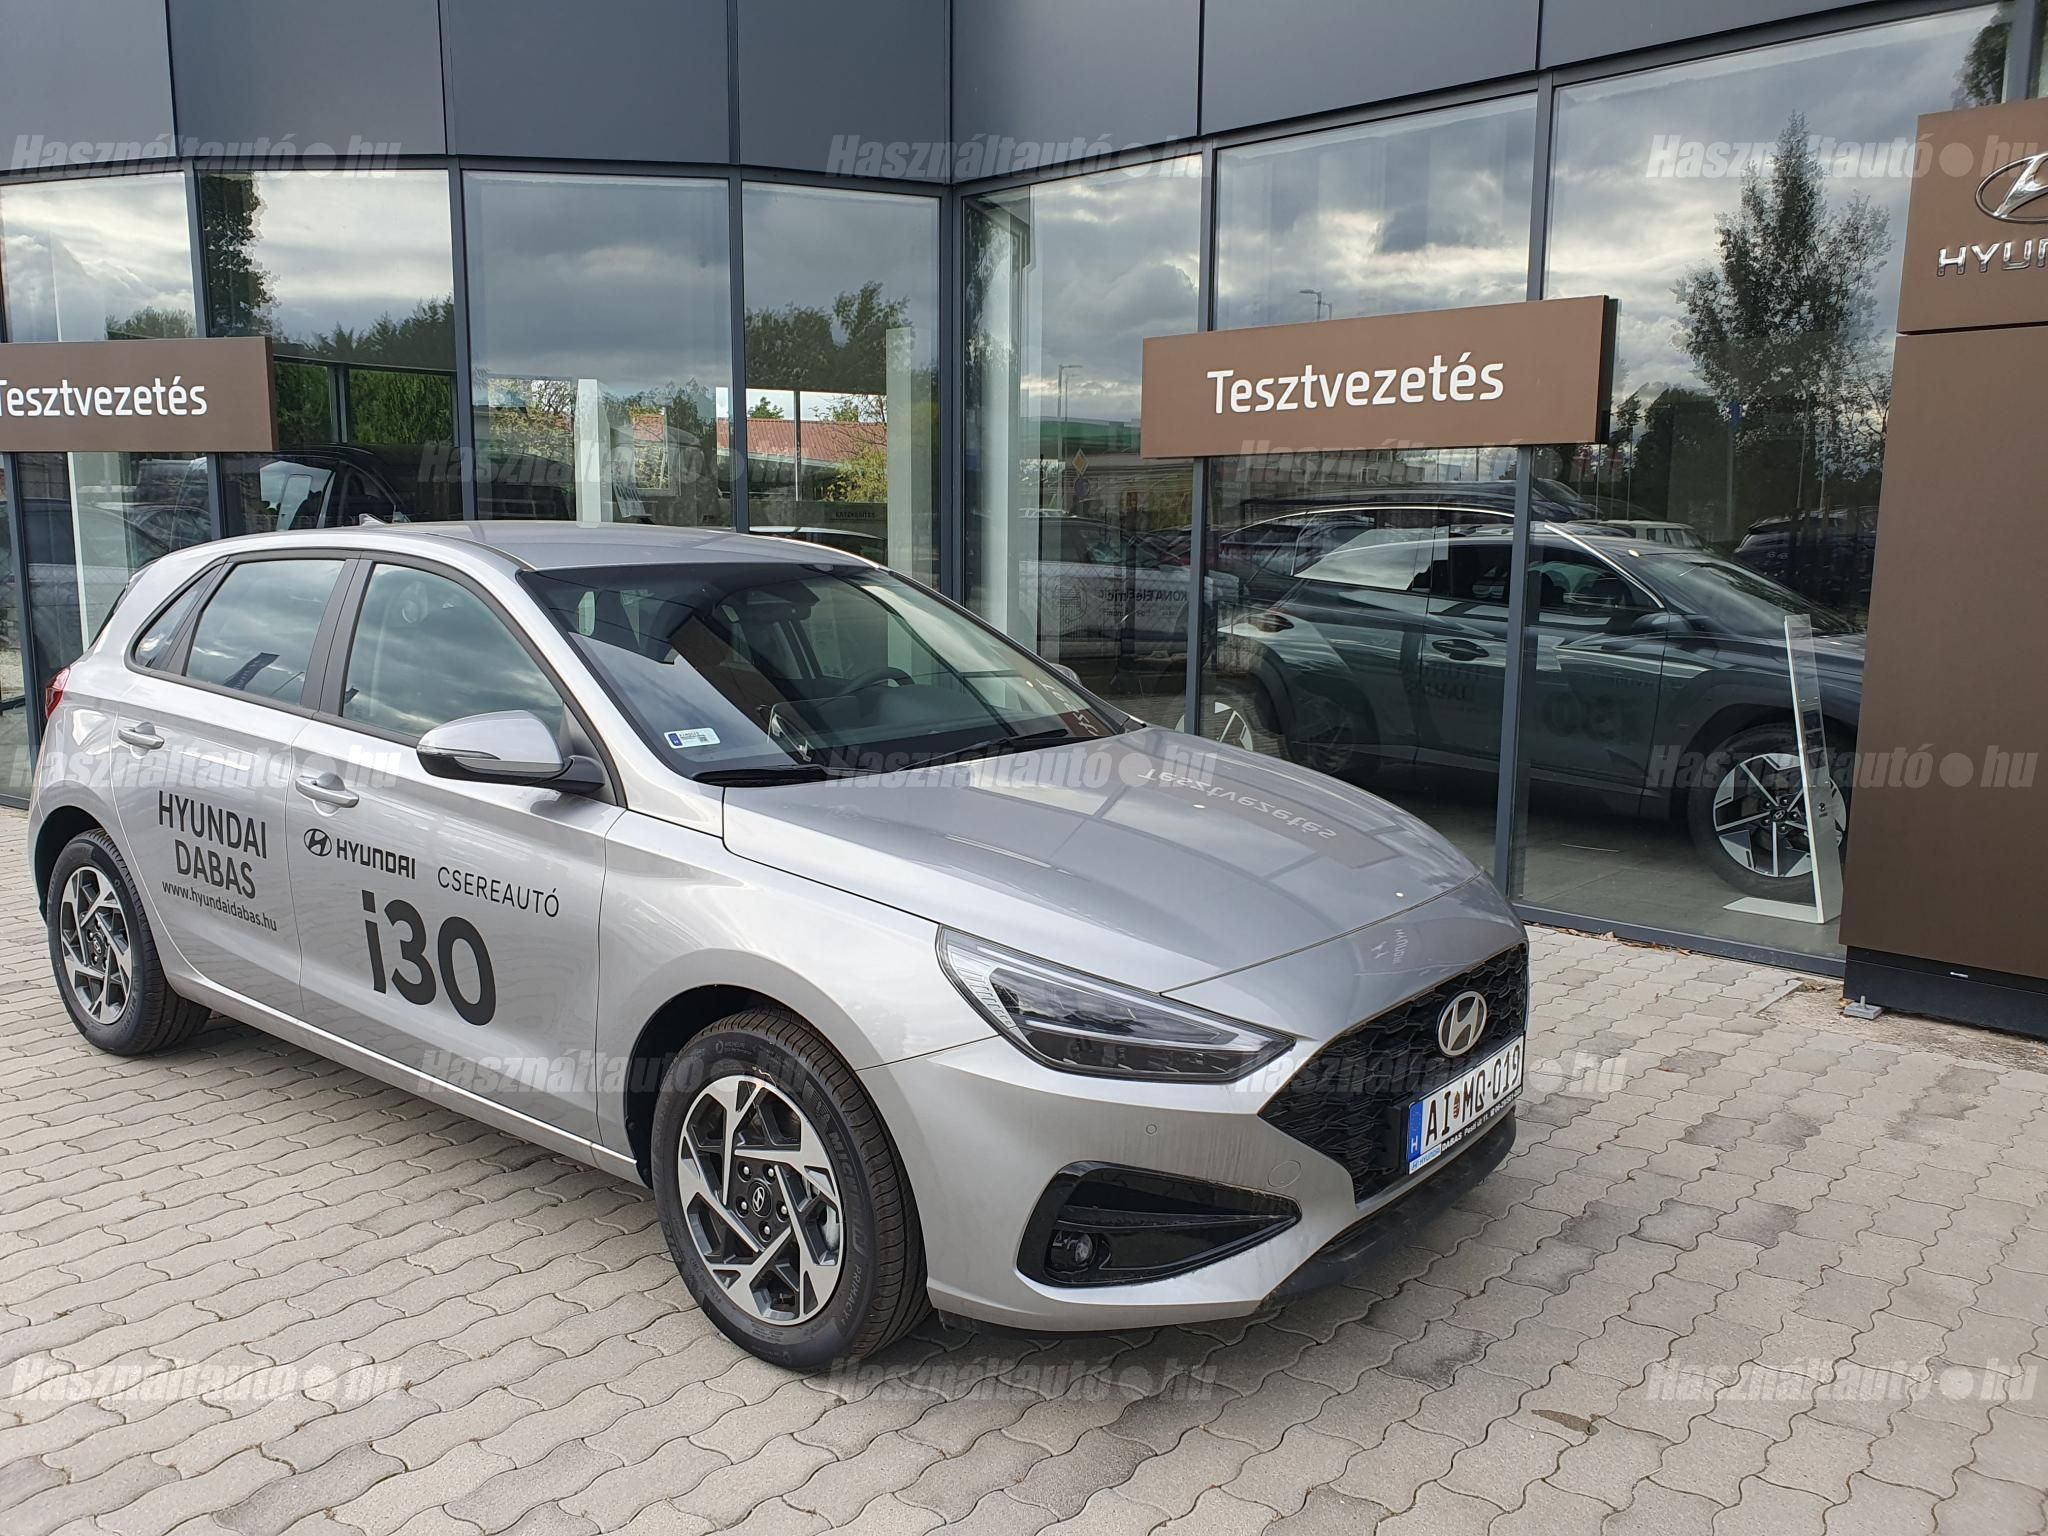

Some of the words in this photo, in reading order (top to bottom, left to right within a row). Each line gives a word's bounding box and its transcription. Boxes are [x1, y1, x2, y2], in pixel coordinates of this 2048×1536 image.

[1207, 351, 1504, 414] Tesztvezetés
[159, 790, 267, 859] HYUNDAI
[175, 839, 256, 899] DABAS
[336, 838, 416, 879] HYUNDAI
[437, 866, 560, 918] CSEREAUTÓ
[162, 881, 277, 931] www.hyundaidabas.hu
[361, 889, 497, 1026] i30
